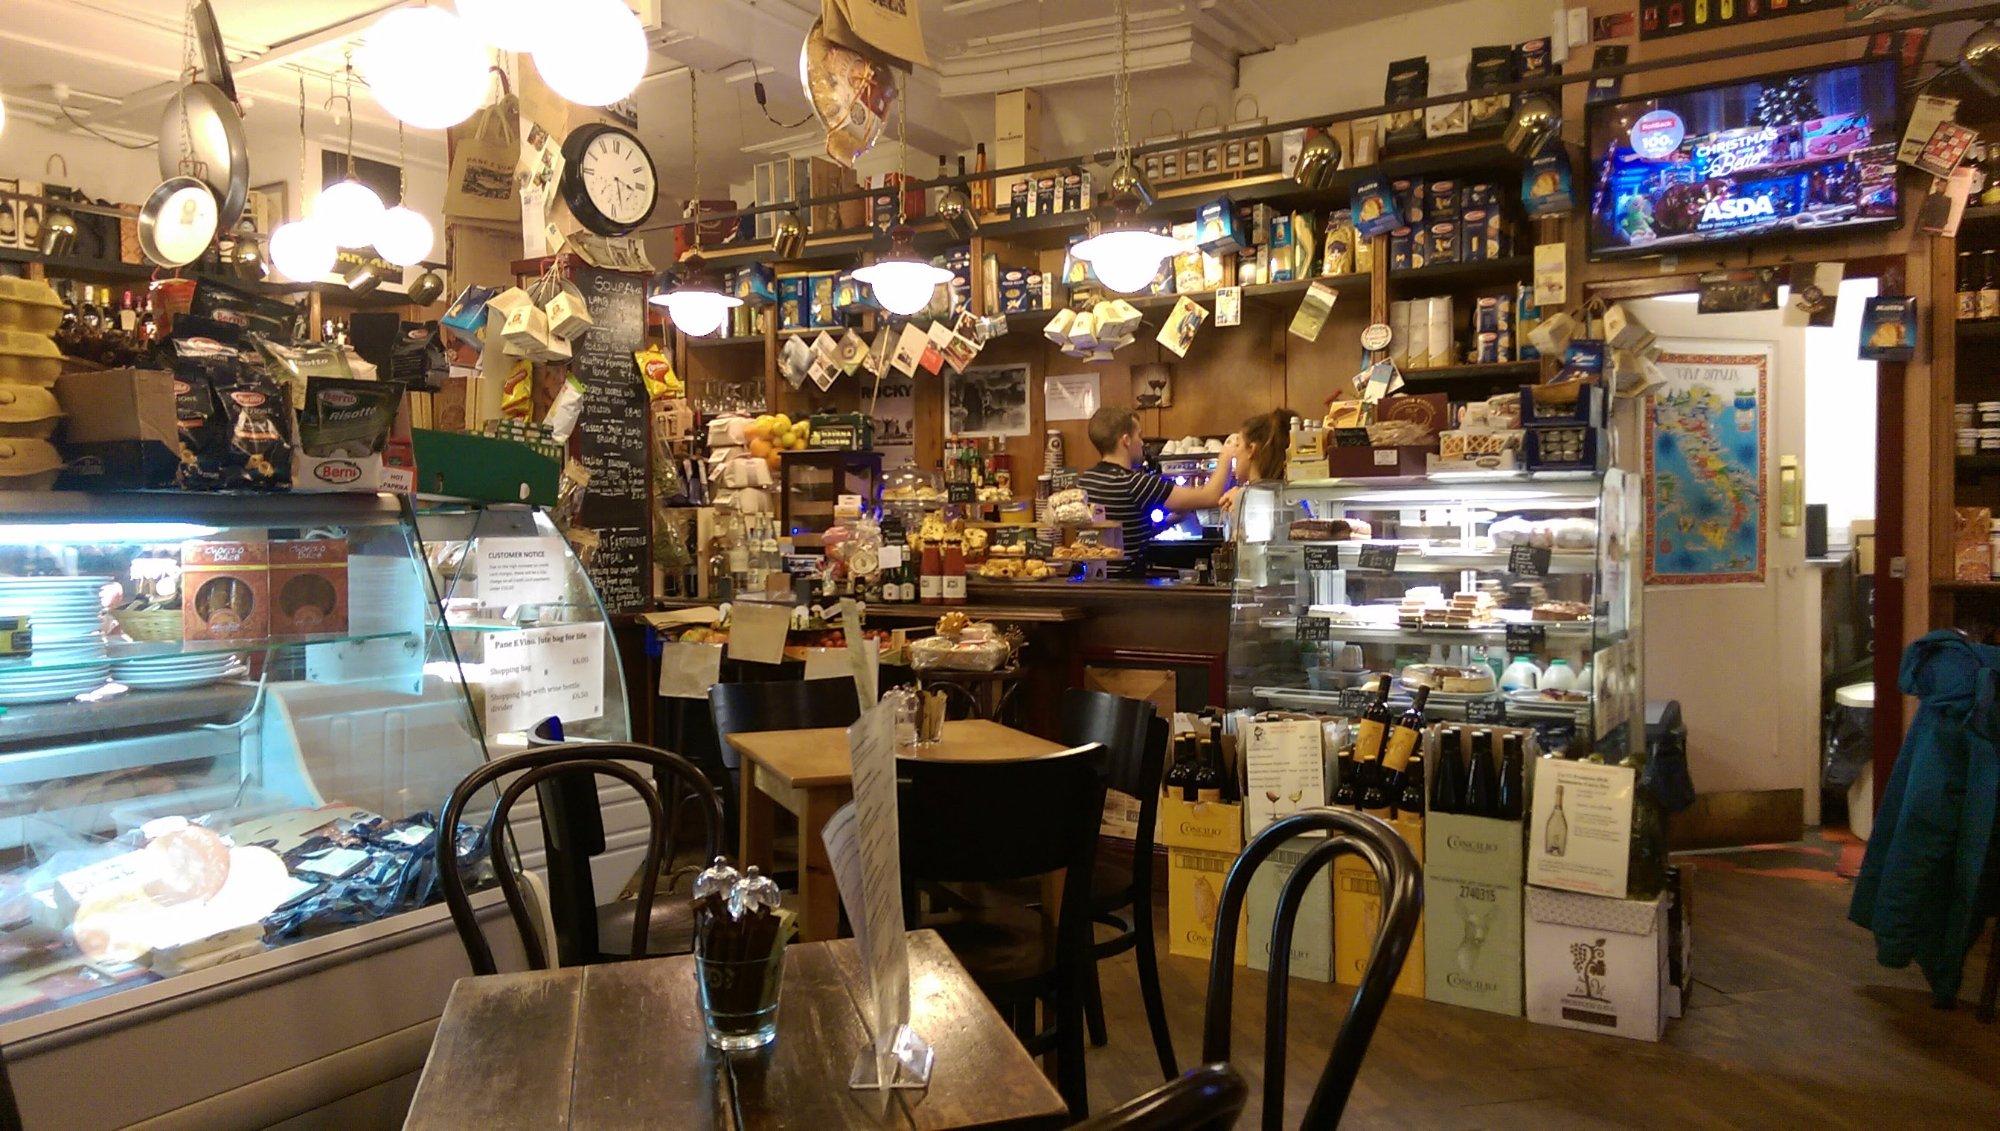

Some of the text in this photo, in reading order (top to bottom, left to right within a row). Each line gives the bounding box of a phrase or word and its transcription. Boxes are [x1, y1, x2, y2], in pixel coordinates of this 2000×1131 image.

[1696, 126, 1778, 158] CHRISTMAS
[1701, 194, 1775, 222] ASDA
[322, 391, 356, 404] Berni
[861, 384, 913, 399] ROCKY
[328, 405, 378, 421] Risotto
[580, 422, 604, 433] Tuscan
[322, 465, 357, 479] Berni
[390, 473, 404, 482] HOT
[488, 550, 545, 560] CUSTOMER NOTICE
[494, 640, 512, 649] Pane
[538, 635, 551, 645] Jute
[552, 634, 564, 644] bag
[565, 632, 575, 641] for
[576, 632, 587, 641] life
[490, 664, 532, 676] Shopping bag
[490, 691, 520, 702] Shopping
[520, 689, 532, 699] bag
[532, 687, 546, 695] with
[562, 682, 580, 691] bottle
[490, 704, 513, 714] divider
